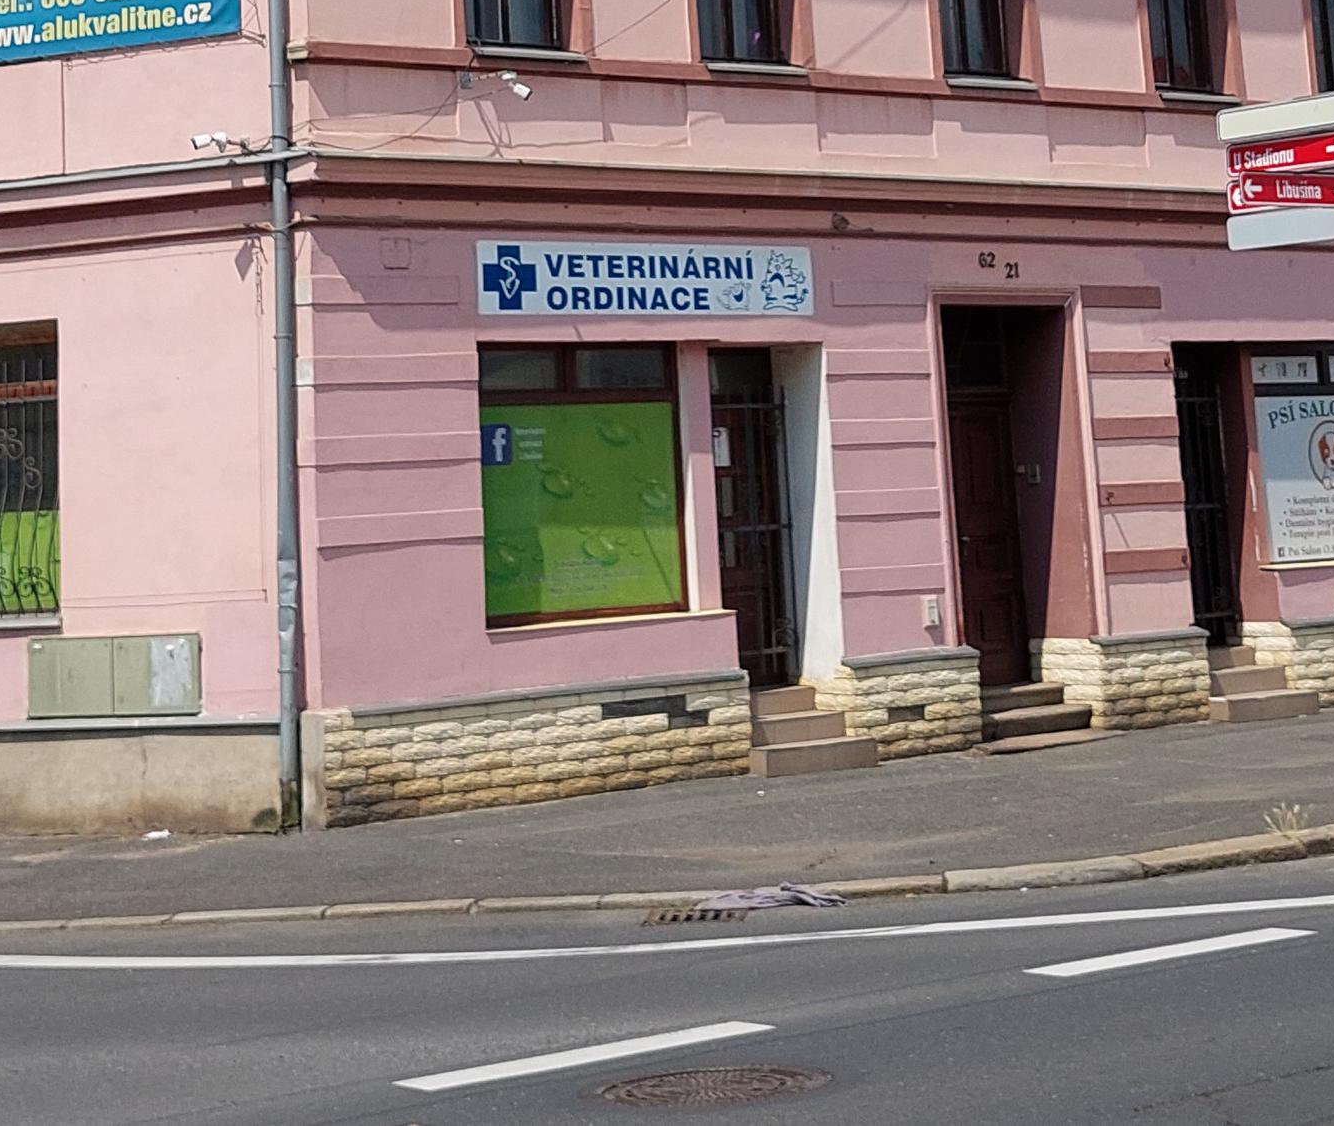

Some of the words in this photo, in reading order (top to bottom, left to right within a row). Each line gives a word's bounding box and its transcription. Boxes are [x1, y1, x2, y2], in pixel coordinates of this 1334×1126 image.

[1233, 153, 1241, 170] U
[1243, 148, 1295, 169] Stadionu
[1275, 180, 1322, 199] Libušina
[544, 249, 754, 280] VETERINÁRNÍ
[978, 251, 996, 269] 62
[1004, 261, 1020, 279] 21
[546, 287, 710, 310] ORDINACE
[1268, 399, 1295, 429] PSÍ
